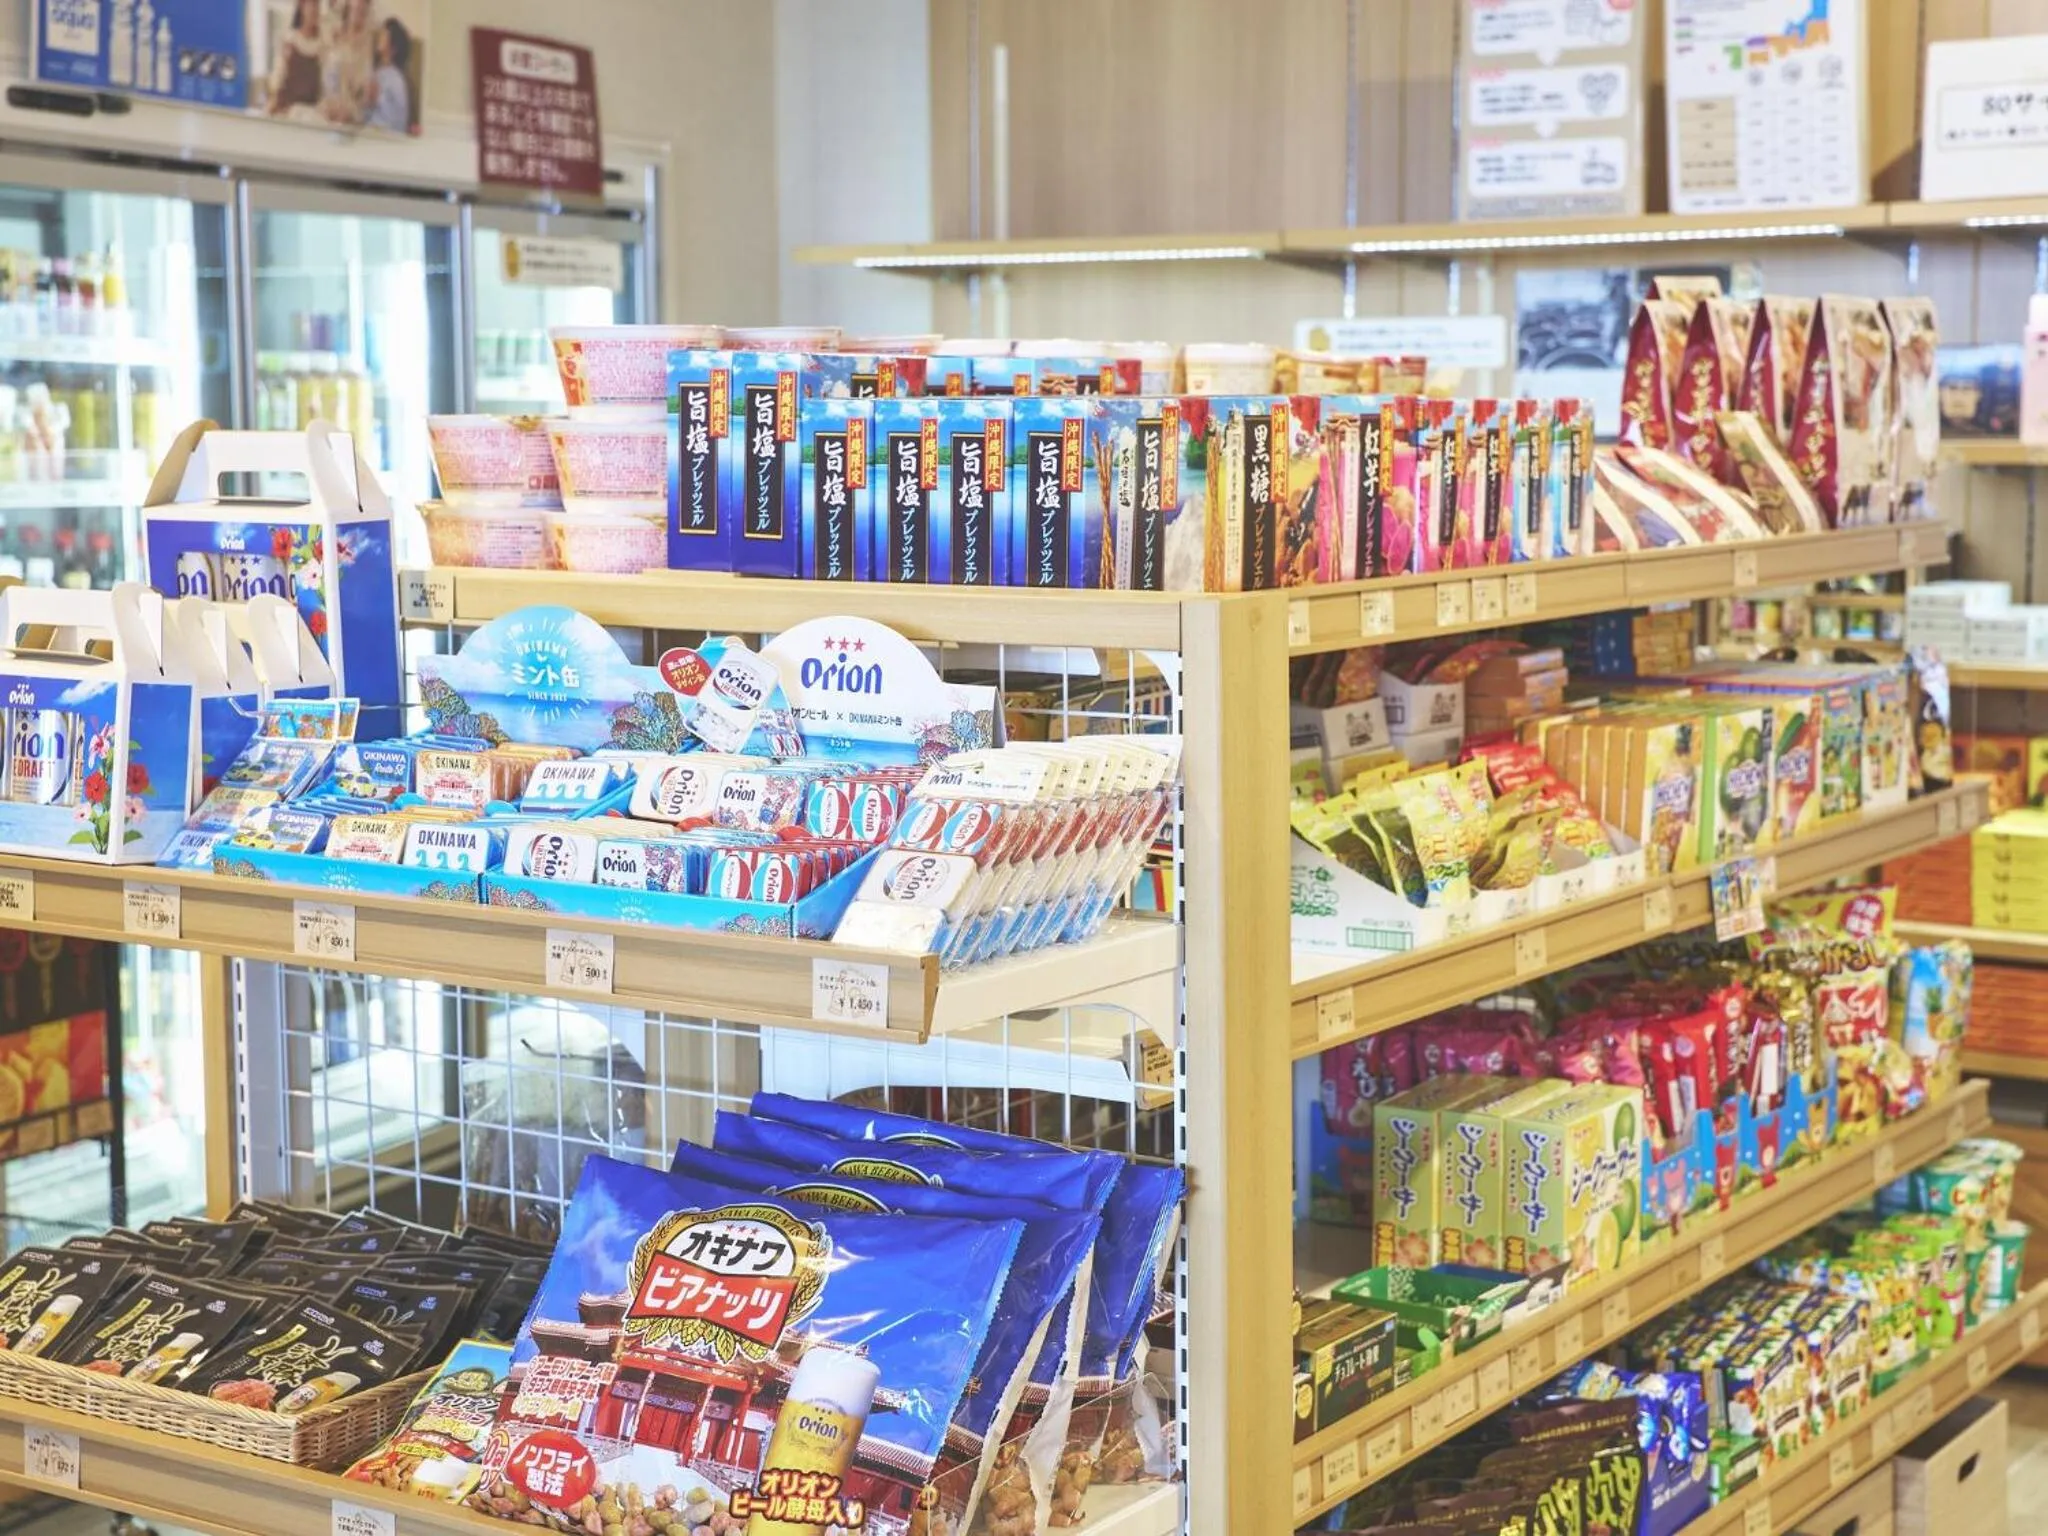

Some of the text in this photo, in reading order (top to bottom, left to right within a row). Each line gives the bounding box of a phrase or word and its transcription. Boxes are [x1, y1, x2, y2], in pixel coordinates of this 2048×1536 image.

[686, 390, 709, 527] 旨塩プレッツェル
[752, 391, 776, 531] 旨塩プレッツェル
[822, 440, 847, 580] 旨塩プレッツェル
[895, 440, 921, 581] 旨塩プレッツェル
[959, 441, 984, 585] 旨塩プレッツェル
[1035, 441, 1061, 585] 旨塩プレッツェル
[509, 663, 581, 689] ミント缶
[719, 668, 762, 701] Orion
[802, 653, 883, 695] Orion
[363, 751, 408, 765] OKINAWA
[435, 756, 472, 770] OKINAWA
[542, 766, 597, 782] OKINAWA
[723, 785, 756, 802] Orion
[351, 821, 387, 834] OKINAWA
[866, 798, 877, 832] Orion
[418, 829, 477, 849] OKINAWA
[603, 854, 638, 874] Orion
[585, 967, 600, 978] 500
[691, 1208, 751, 1223] OKINAWA
[752, 1208, 783, 1224] BEER
[680, 1229, 787, 1271] オキナワ
[643, 1264, 784, 1331] ビアナッツ
[435, 1394, 500, 1414] オリオン
[798, 1416, 839, 1441] Orion
[513, 1444, 590, 1478] ノンフライ
[525, 1468, 566, 1498] 製法
[760, 1470, 841, 1498] オリオン
[731, 1491, 864, 1527] ビール酵母入り
